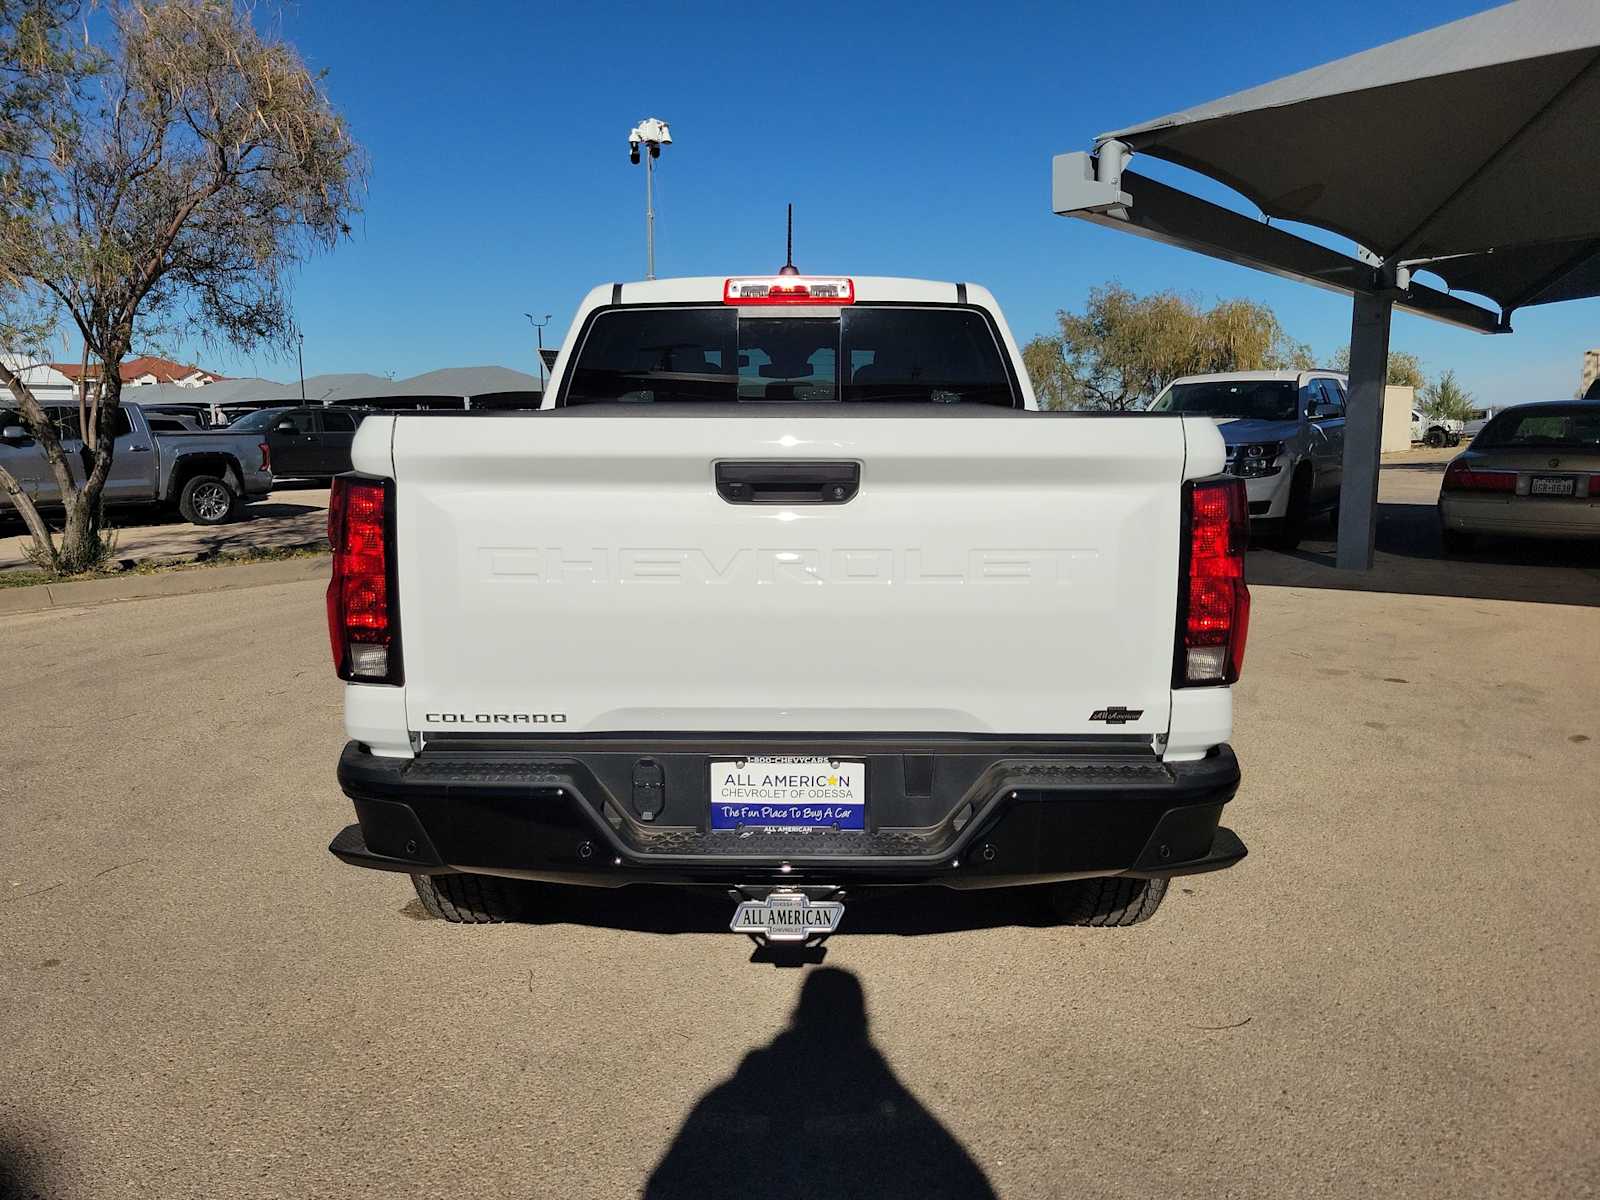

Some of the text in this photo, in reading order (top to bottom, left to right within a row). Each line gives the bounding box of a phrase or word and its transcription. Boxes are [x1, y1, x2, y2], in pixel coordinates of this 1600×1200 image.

[476, 546, 1102, 584] CHEVROLET
[426, 713, 567, 723] COLORADO
[724, 774, 850, 787] ALL AMERICN
[721, 788, 853, 799] CHEVROLET OF ODESSA
[721, 806, 852, 821] The Fun Place To Buy A Car
[743, 909, 832, 925] ALL AMERICAN
